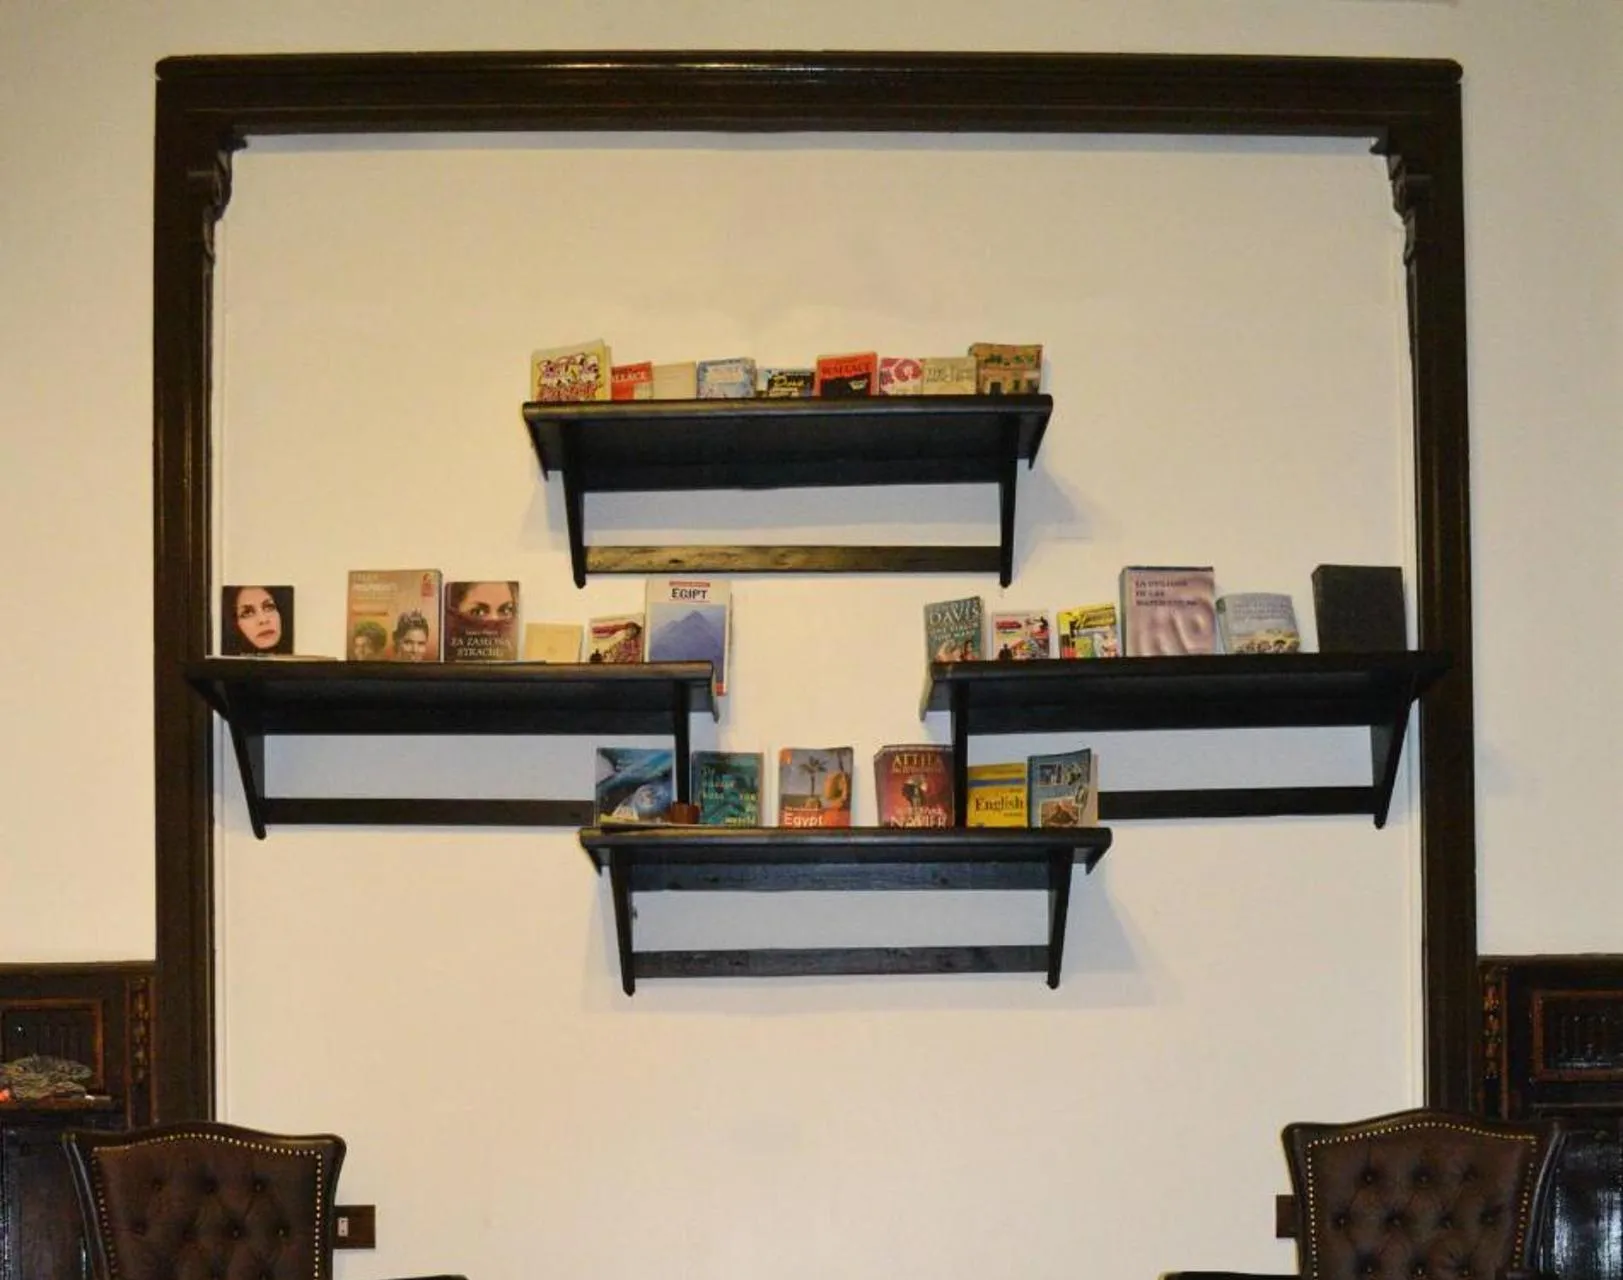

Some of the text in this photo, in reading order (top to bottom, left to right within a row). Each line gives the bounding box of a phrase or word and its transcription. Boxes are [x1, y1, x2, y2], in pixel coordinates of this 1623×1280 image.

[671, 587, 708, 599] EGIPT
[929, 606, 979, 625] DAVIS
[975, 796, 1023, 812] English
[784, 812, 824, 828] Egypt
